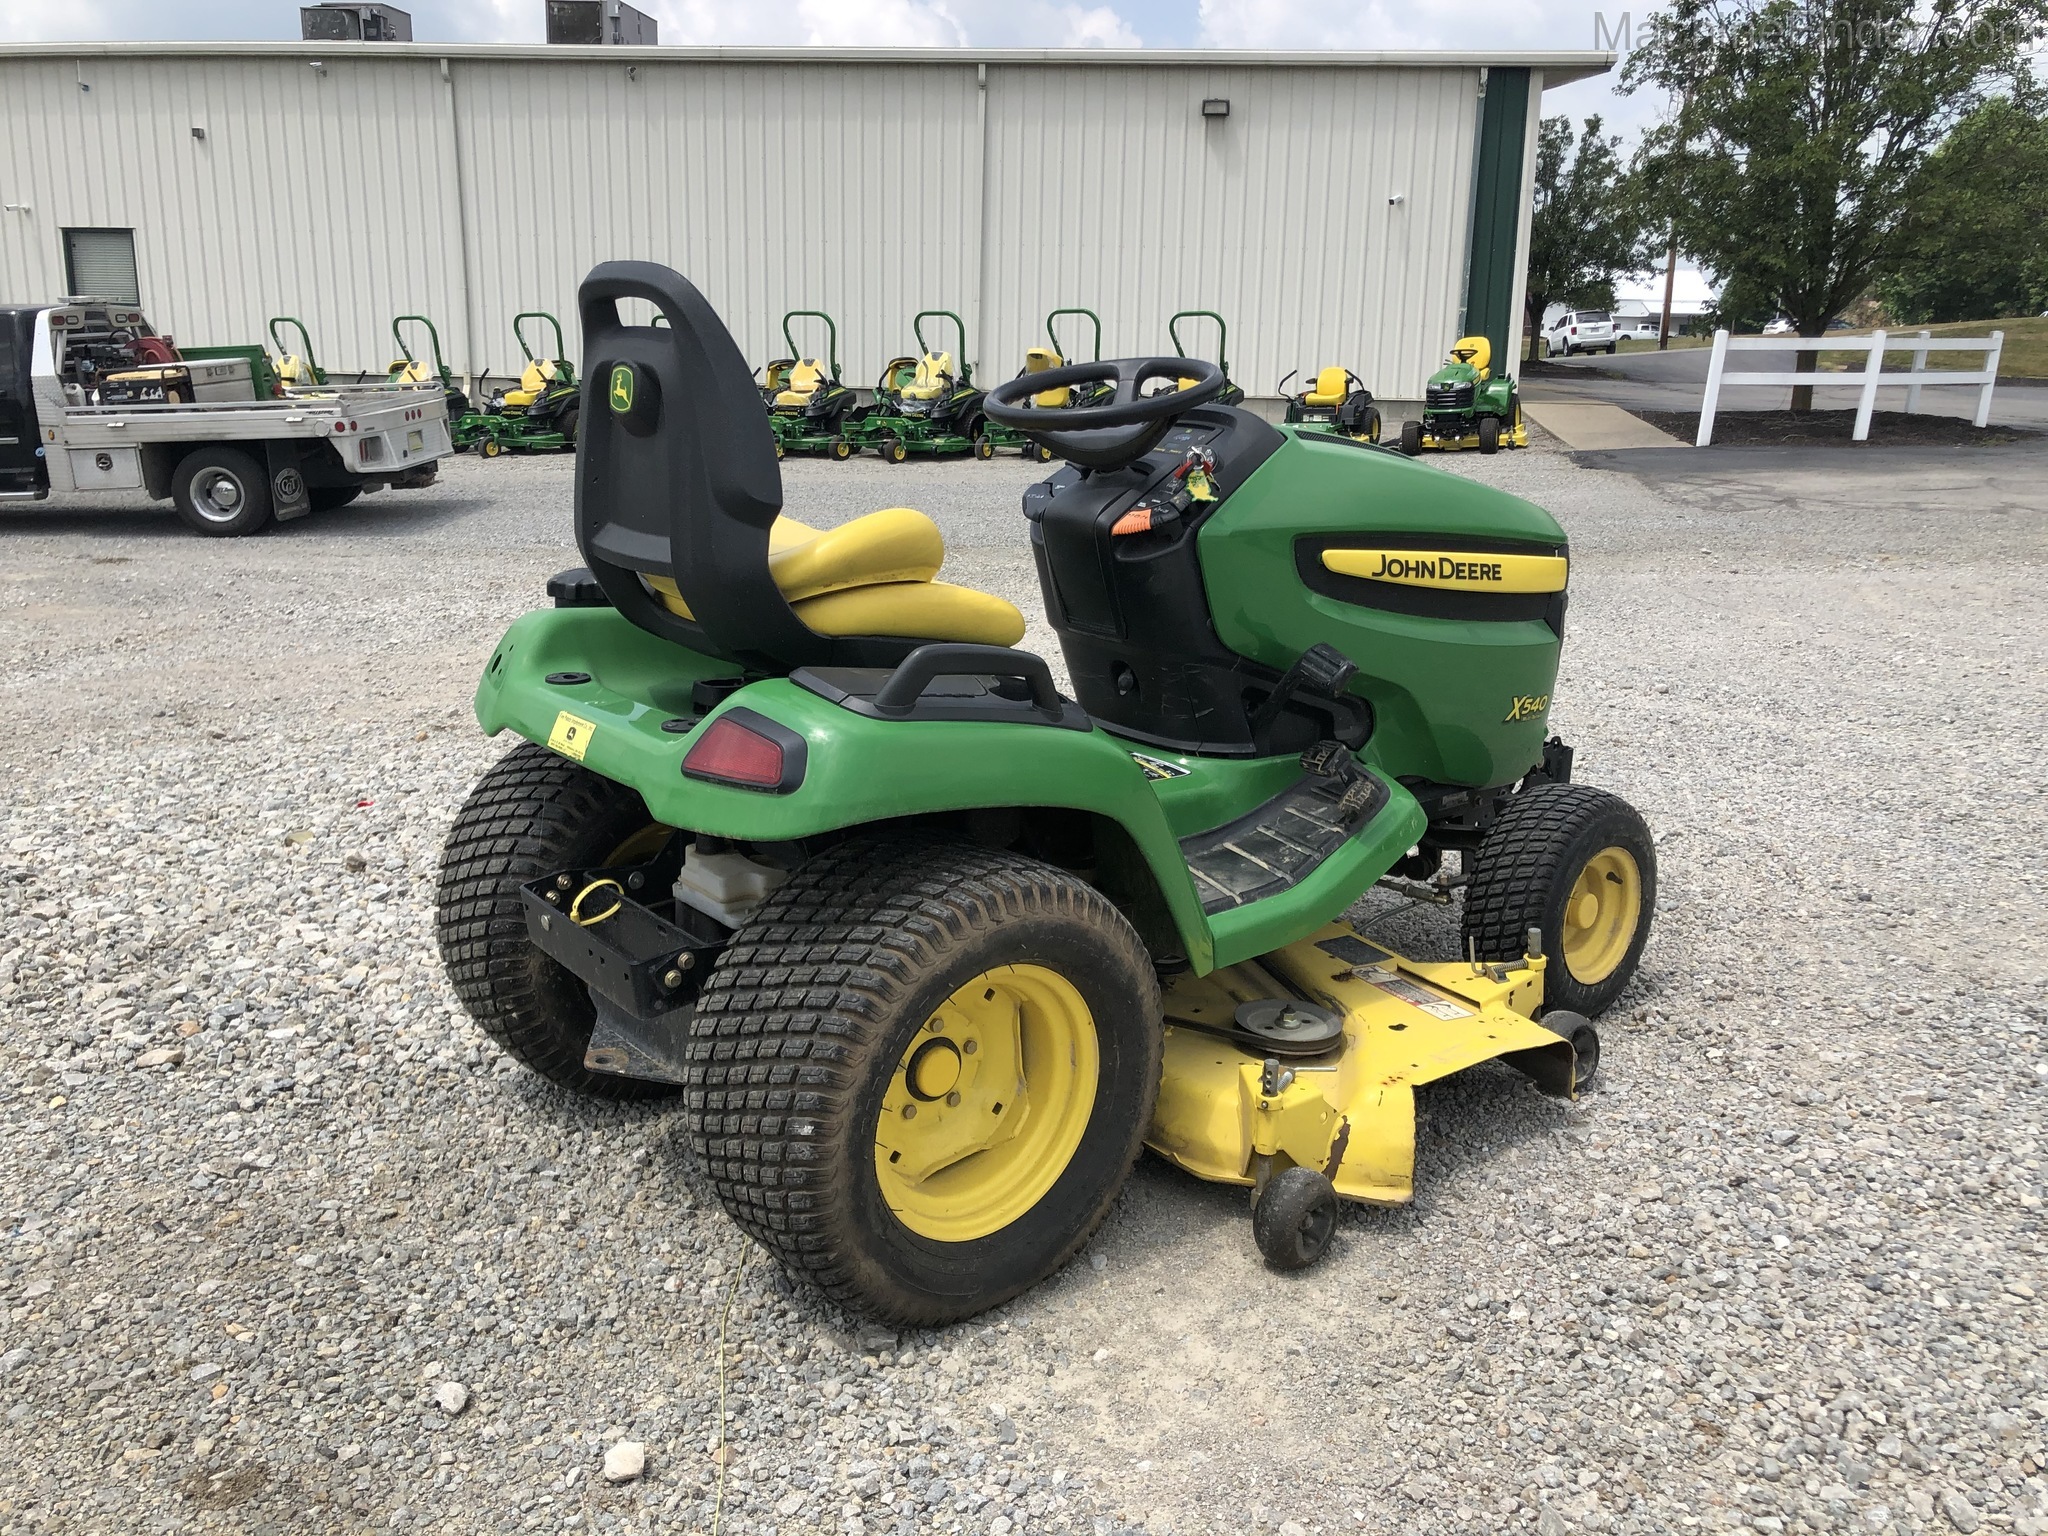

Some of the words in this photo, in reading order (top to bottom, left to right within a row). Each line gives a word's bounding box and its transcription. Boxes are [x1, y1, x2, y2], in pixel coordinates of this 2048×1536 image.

[1371, 554, 1436, 579] JOHN
[1438, 557, 1503, 581] DEERE
[1503, 694, 1549, 723] X540
